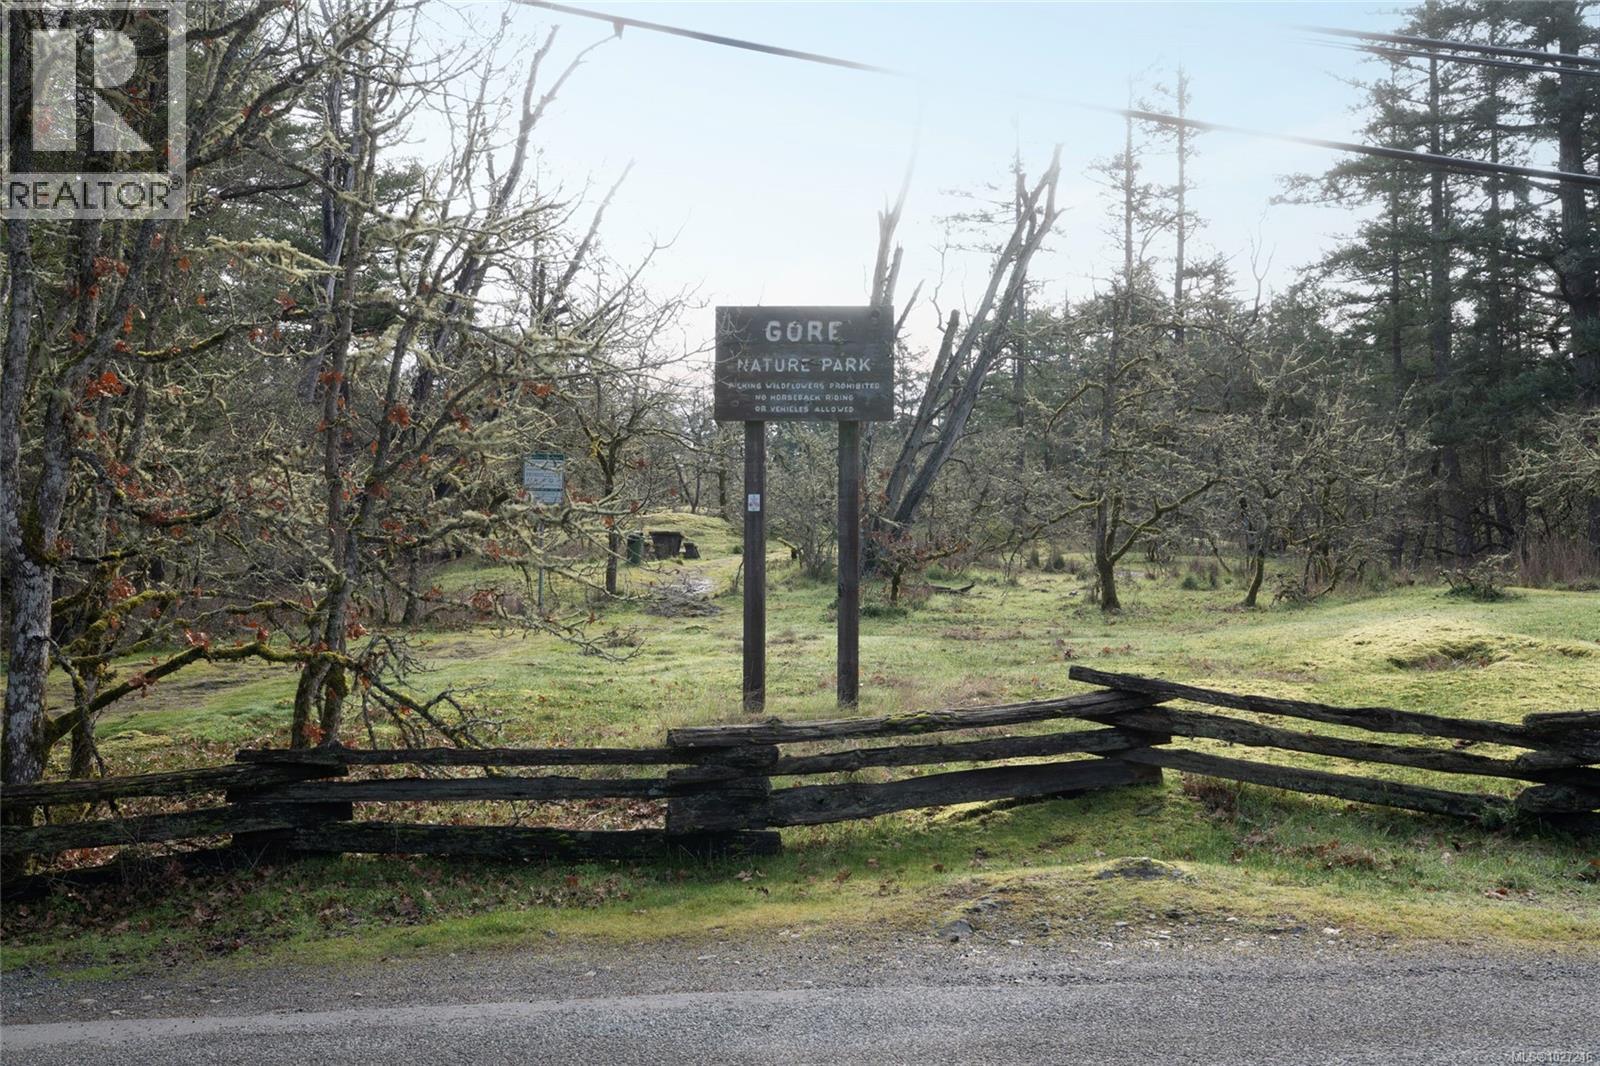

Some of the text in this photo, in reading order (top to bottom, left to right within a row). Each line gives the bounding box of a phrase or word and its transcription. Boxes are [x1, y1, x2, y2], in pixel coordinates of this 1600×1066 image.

[765, 320, 843, 342] GORE
[737, 358, 871, 373] NATURE PARK
[765, 382, 825, 390] WILDFLOWERS
[829, 382, 880, 390] PROHIBITED
[755, 405, 855, 413] OR VEHICLES ALLOWED
